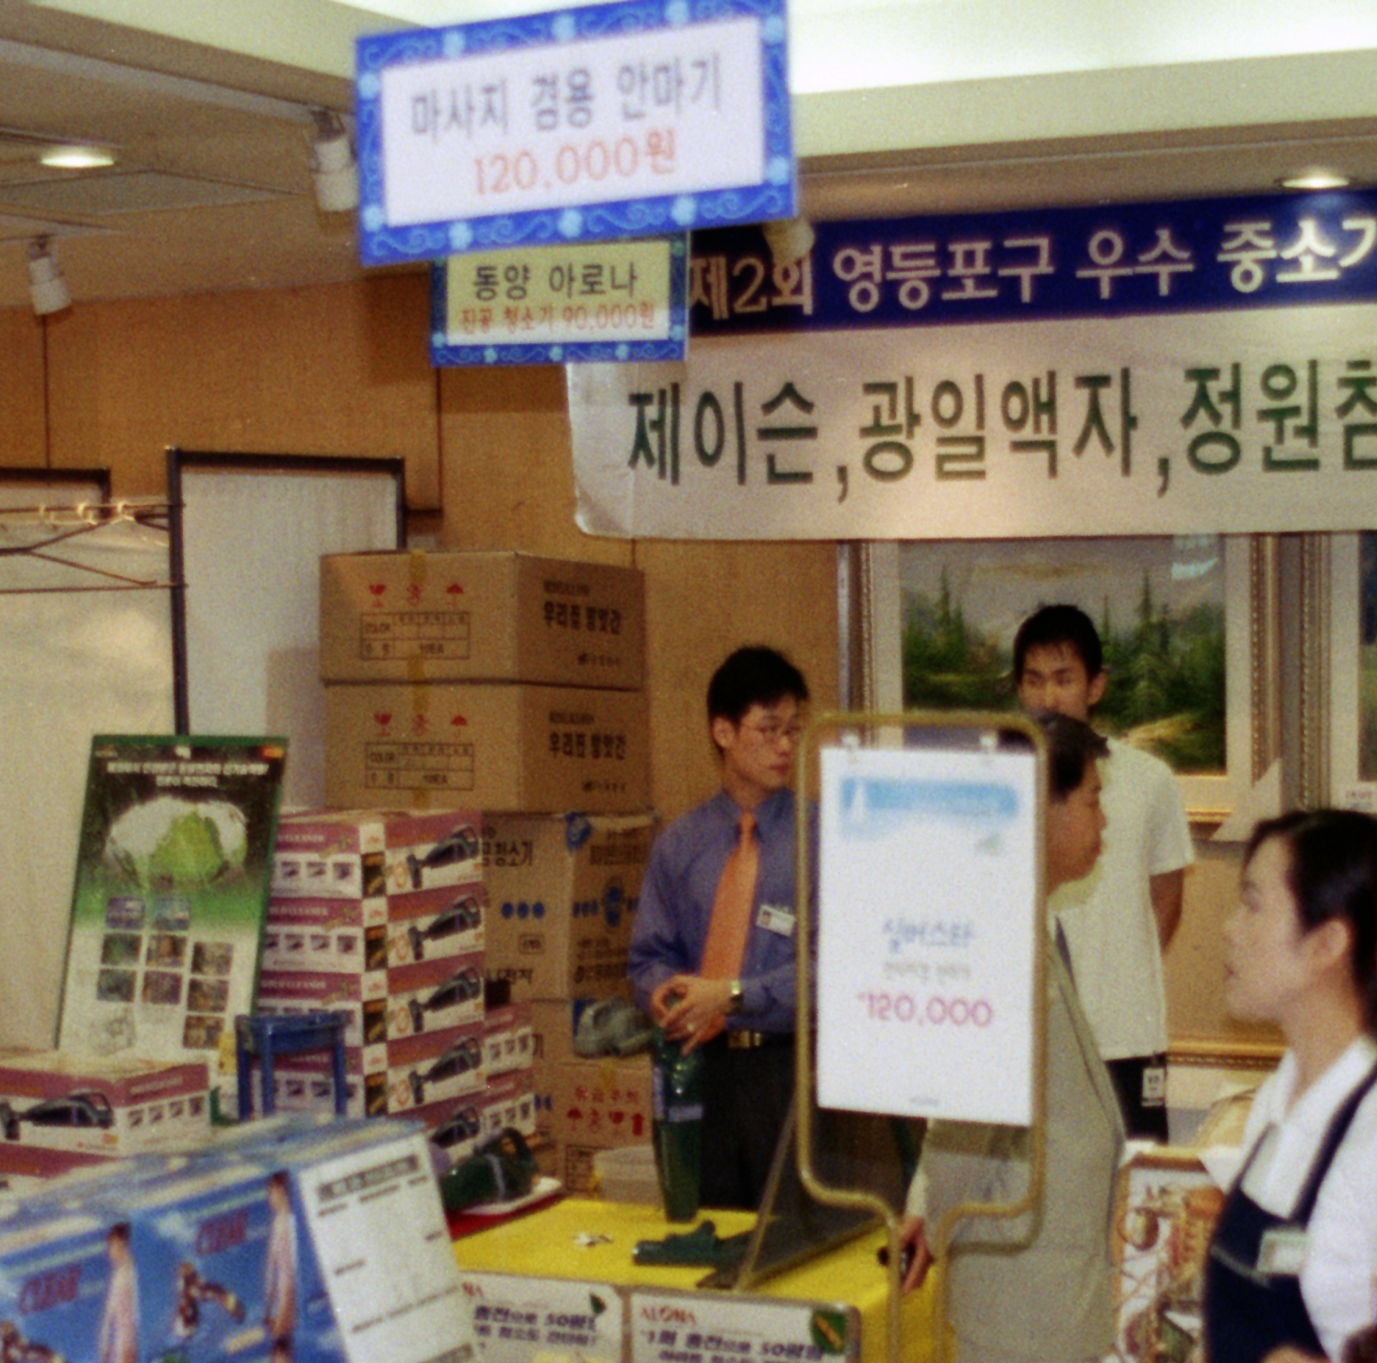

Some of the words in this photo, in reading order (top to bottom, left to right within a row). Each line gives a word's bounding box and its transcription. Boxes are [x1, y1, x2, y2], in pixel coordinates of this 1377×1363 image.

[410, 78, 512, 138] 마사지
[531, 66, 594, 133] 겸용
[616, 50, 722, 122] 안마기
[472, 264, 530, 302] 동양
[548, 261, 638, 297] 아로나
[688, 256, 814, 320] 제2회
[833, 234, 1055, 313] 영등포구
[1075, 228, 1196, 300] 우수
